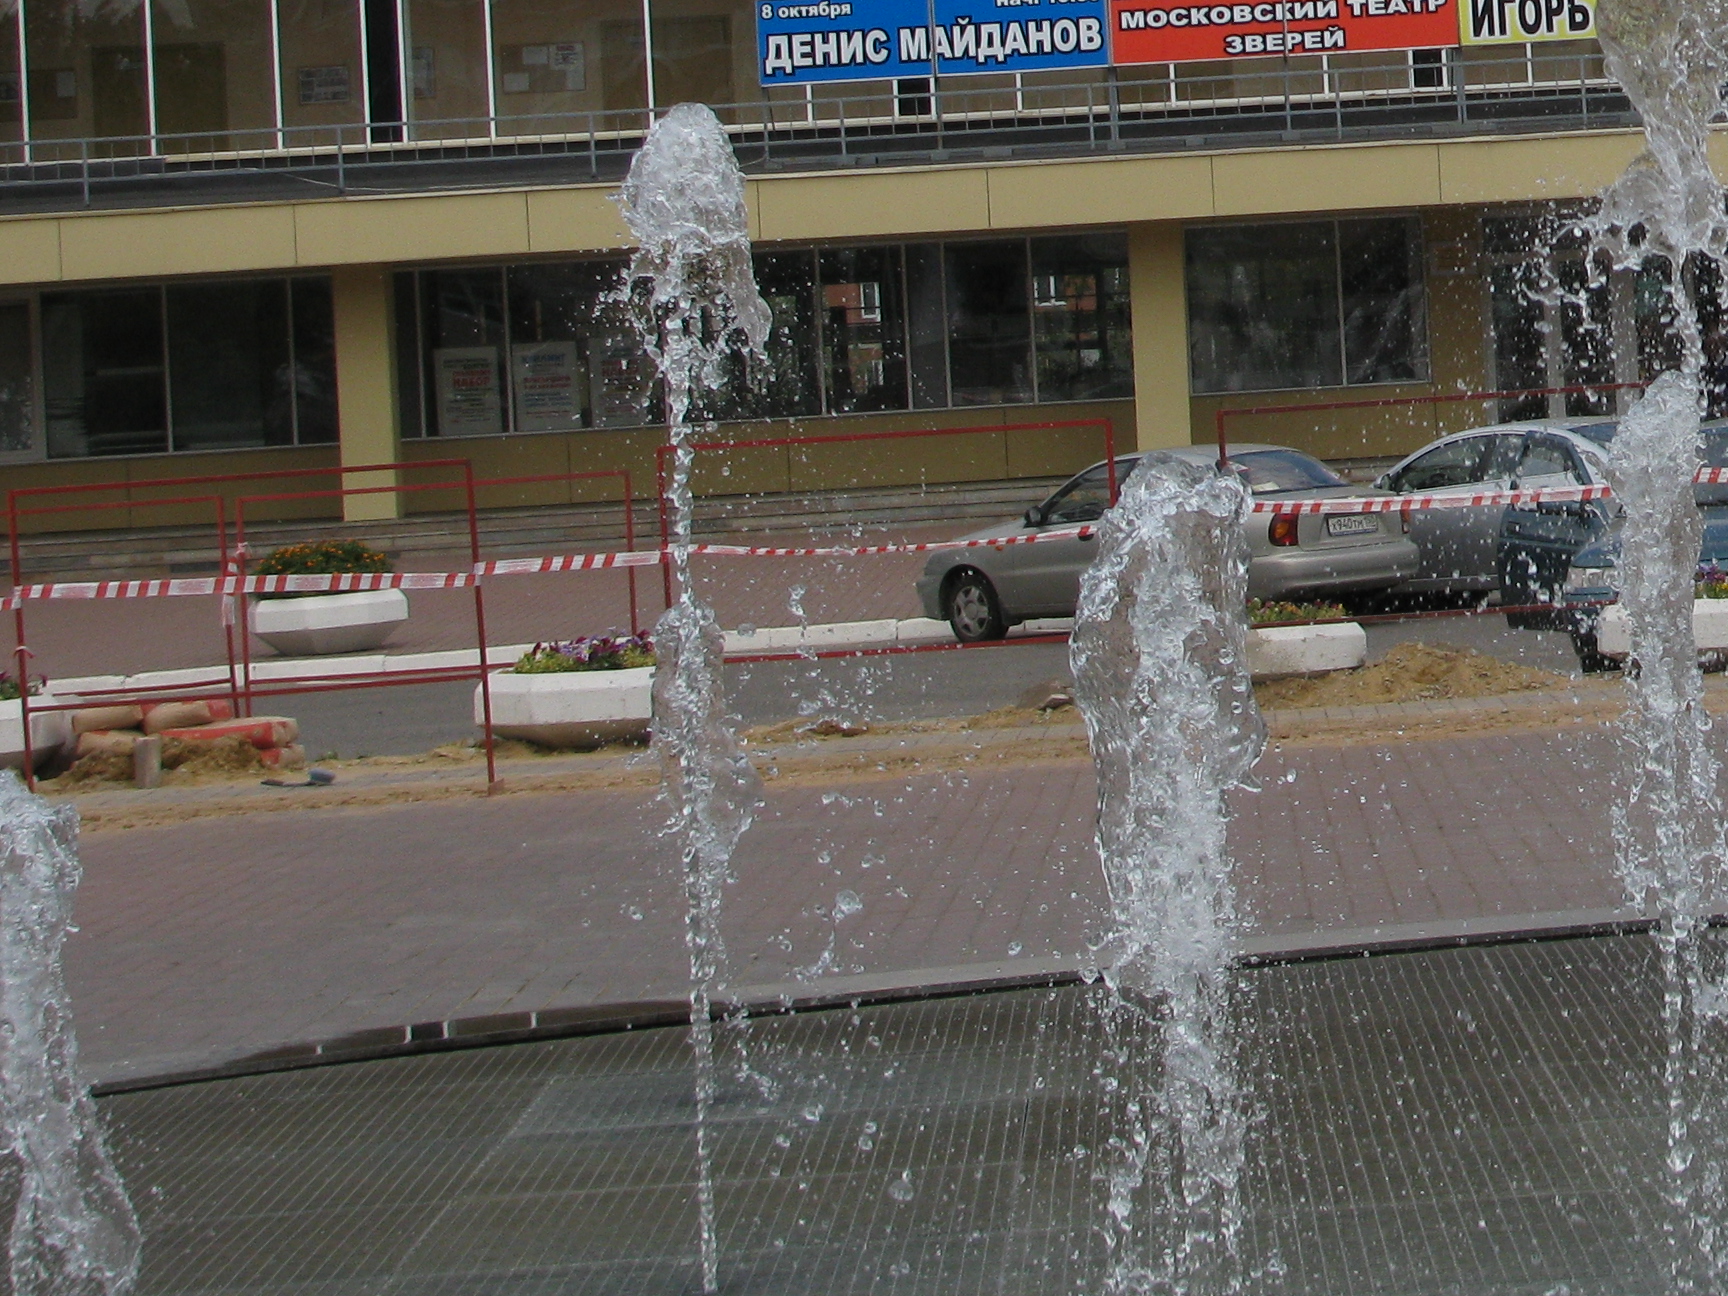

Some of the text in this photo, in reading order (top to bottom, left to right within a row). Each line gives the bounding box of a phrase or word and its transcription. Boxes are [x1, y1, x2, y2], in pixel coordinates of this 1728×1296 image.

[760, 1, 852, 21] 8 октября
[763, 15, 1104, 77] ДЕНИС МАЙДАНОВ
[1223, 26, 1346, 54] ЗВЕРЕЙ
